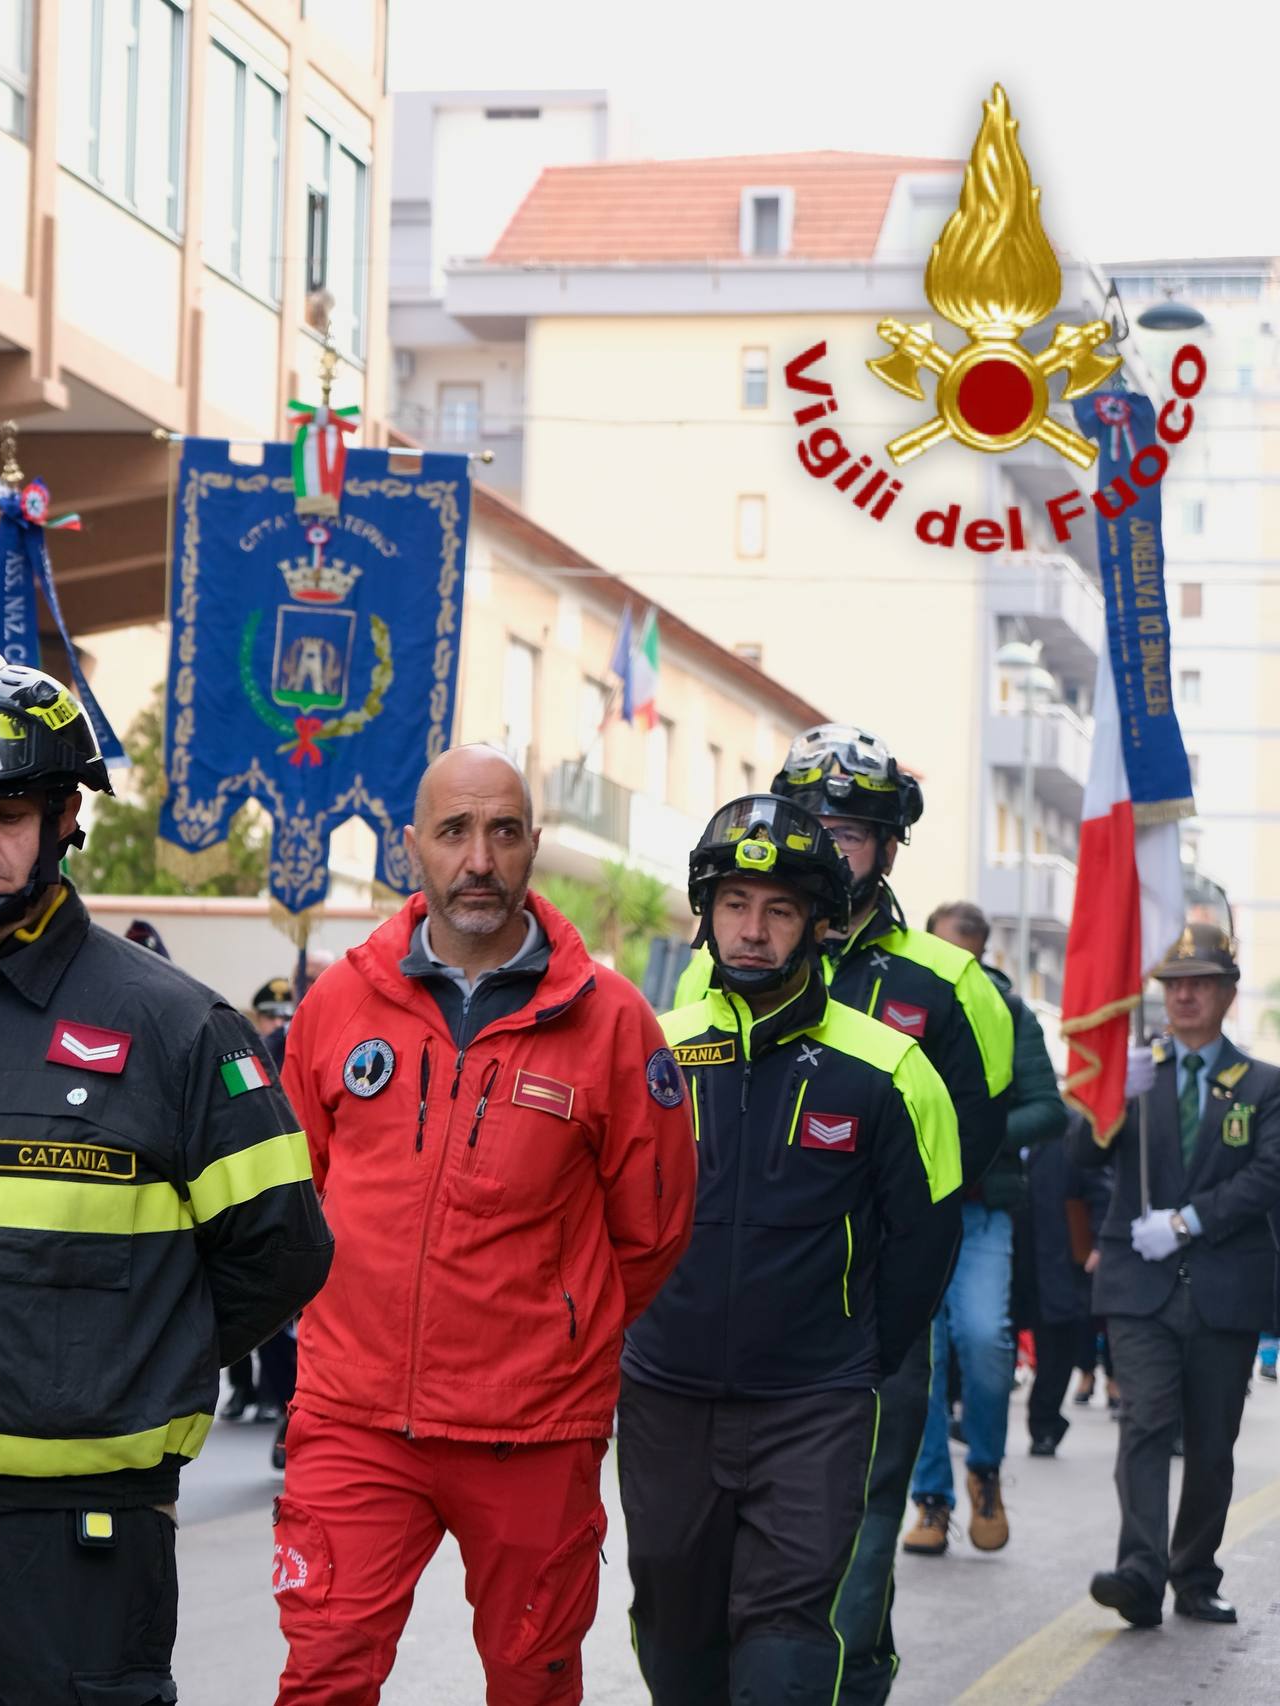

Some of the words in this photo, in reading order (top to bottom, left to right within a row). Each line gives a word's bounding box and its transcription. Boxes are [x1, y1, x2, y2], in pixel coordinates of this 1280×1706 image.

[1137, 615, 1165, 635] DI
[673, 1046, 723, 1063] ATANIA
[18, 1147, 111, 1171] CATANIA
